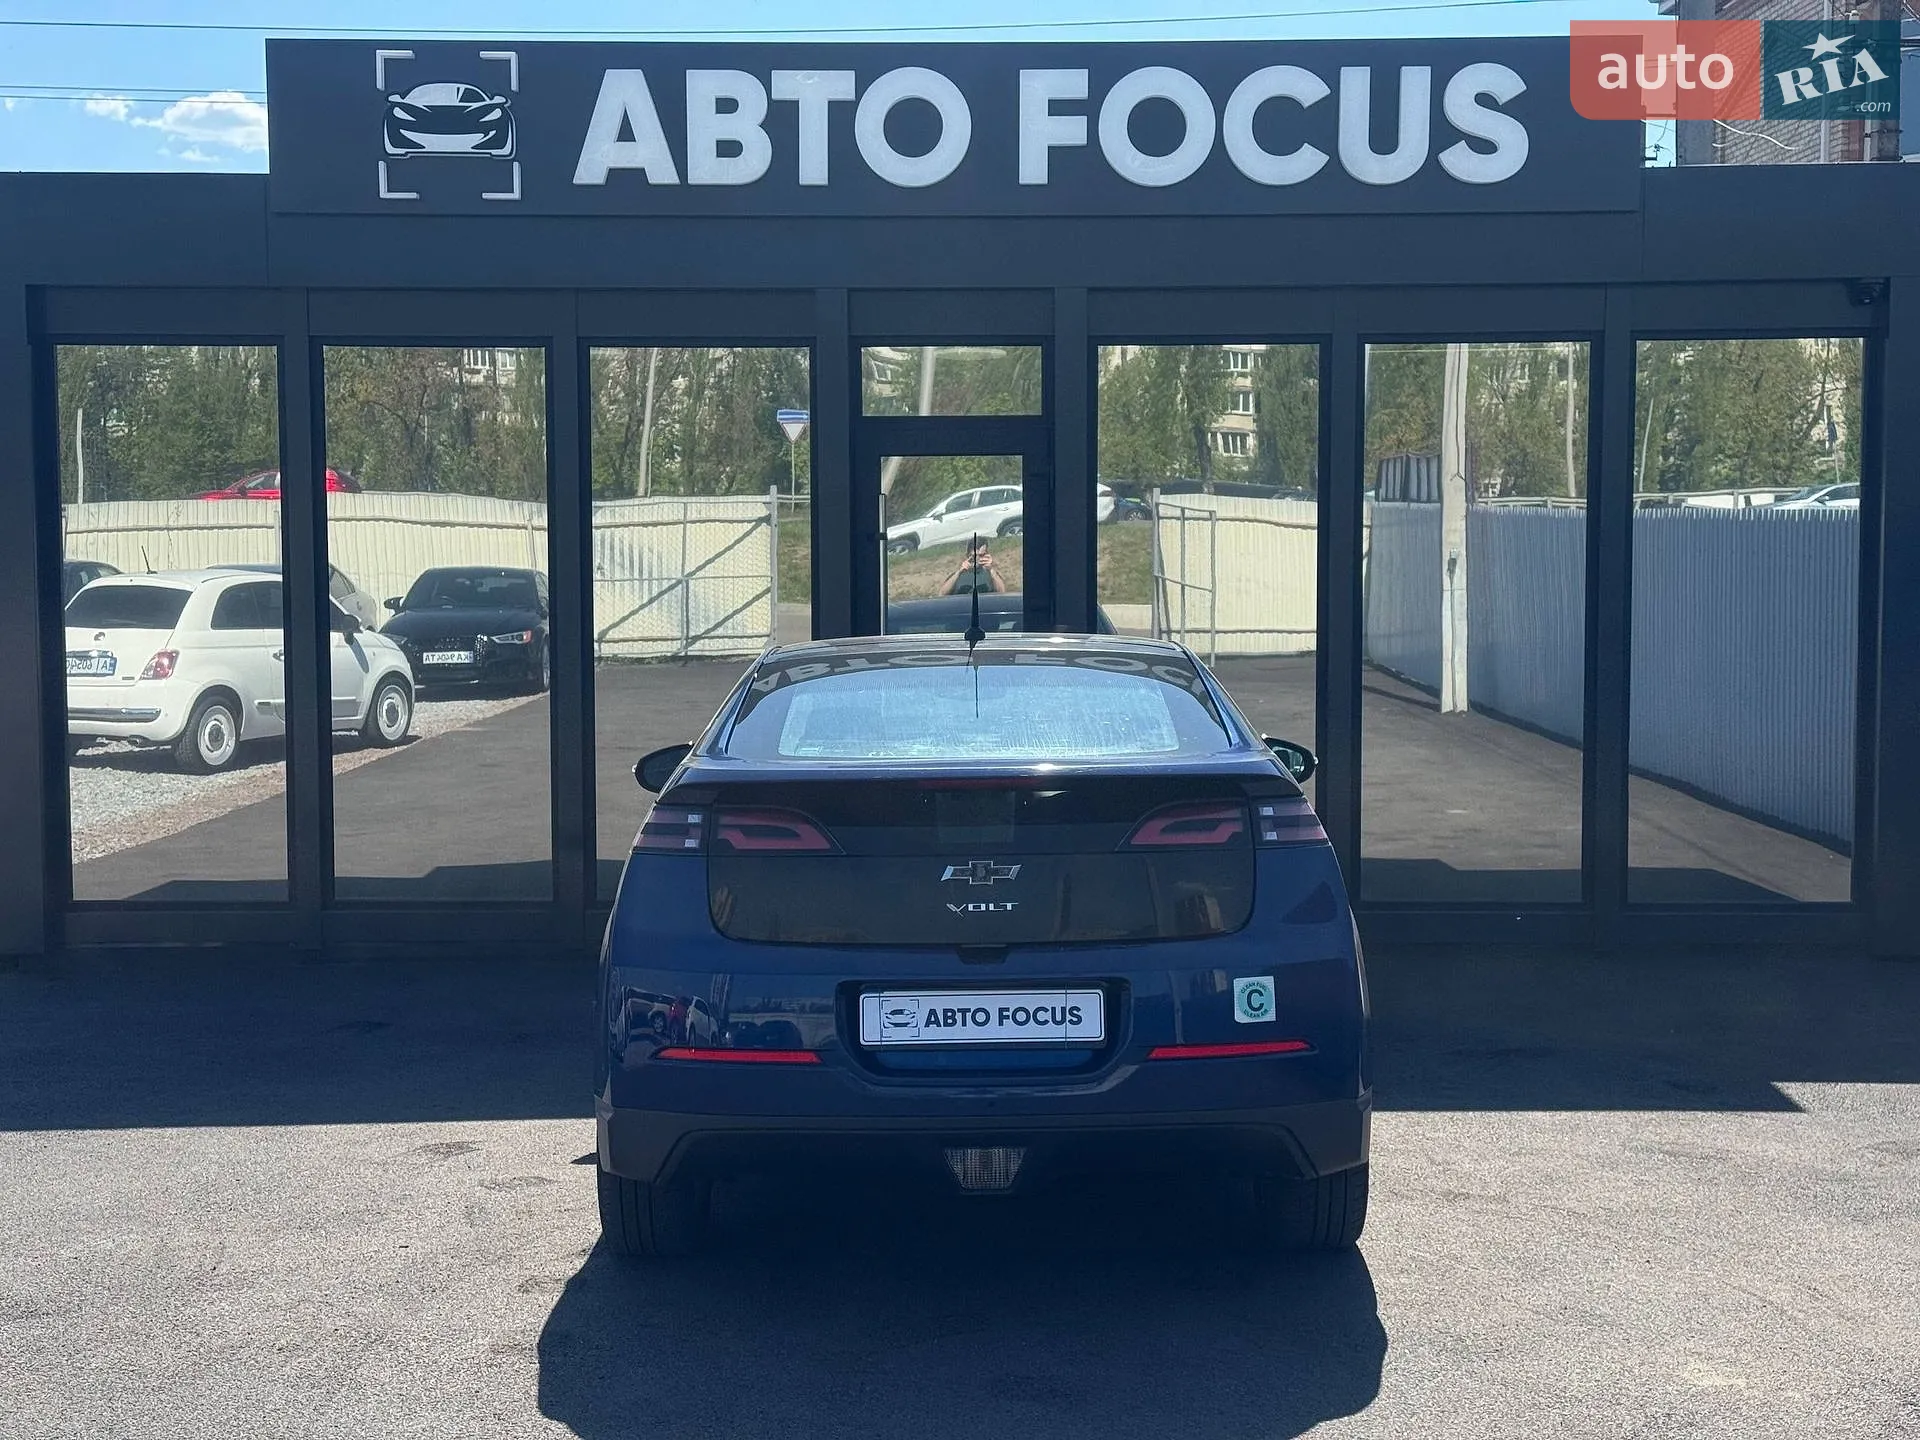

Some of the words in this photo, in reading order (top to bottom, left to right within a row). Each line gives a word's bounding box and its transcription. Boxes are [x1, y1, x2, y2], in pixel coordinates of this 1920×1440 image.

[572, 66, 972, 188] АВТО
[1018, 62, 1530, 187] FOCUS
[946, 902, 1019, 917] VOLT
[1246, 988, 1265, 1012] C
[924, 1007, 991, 1028] АВТО
[998, 1005, 1083, 1027] FOCUS
